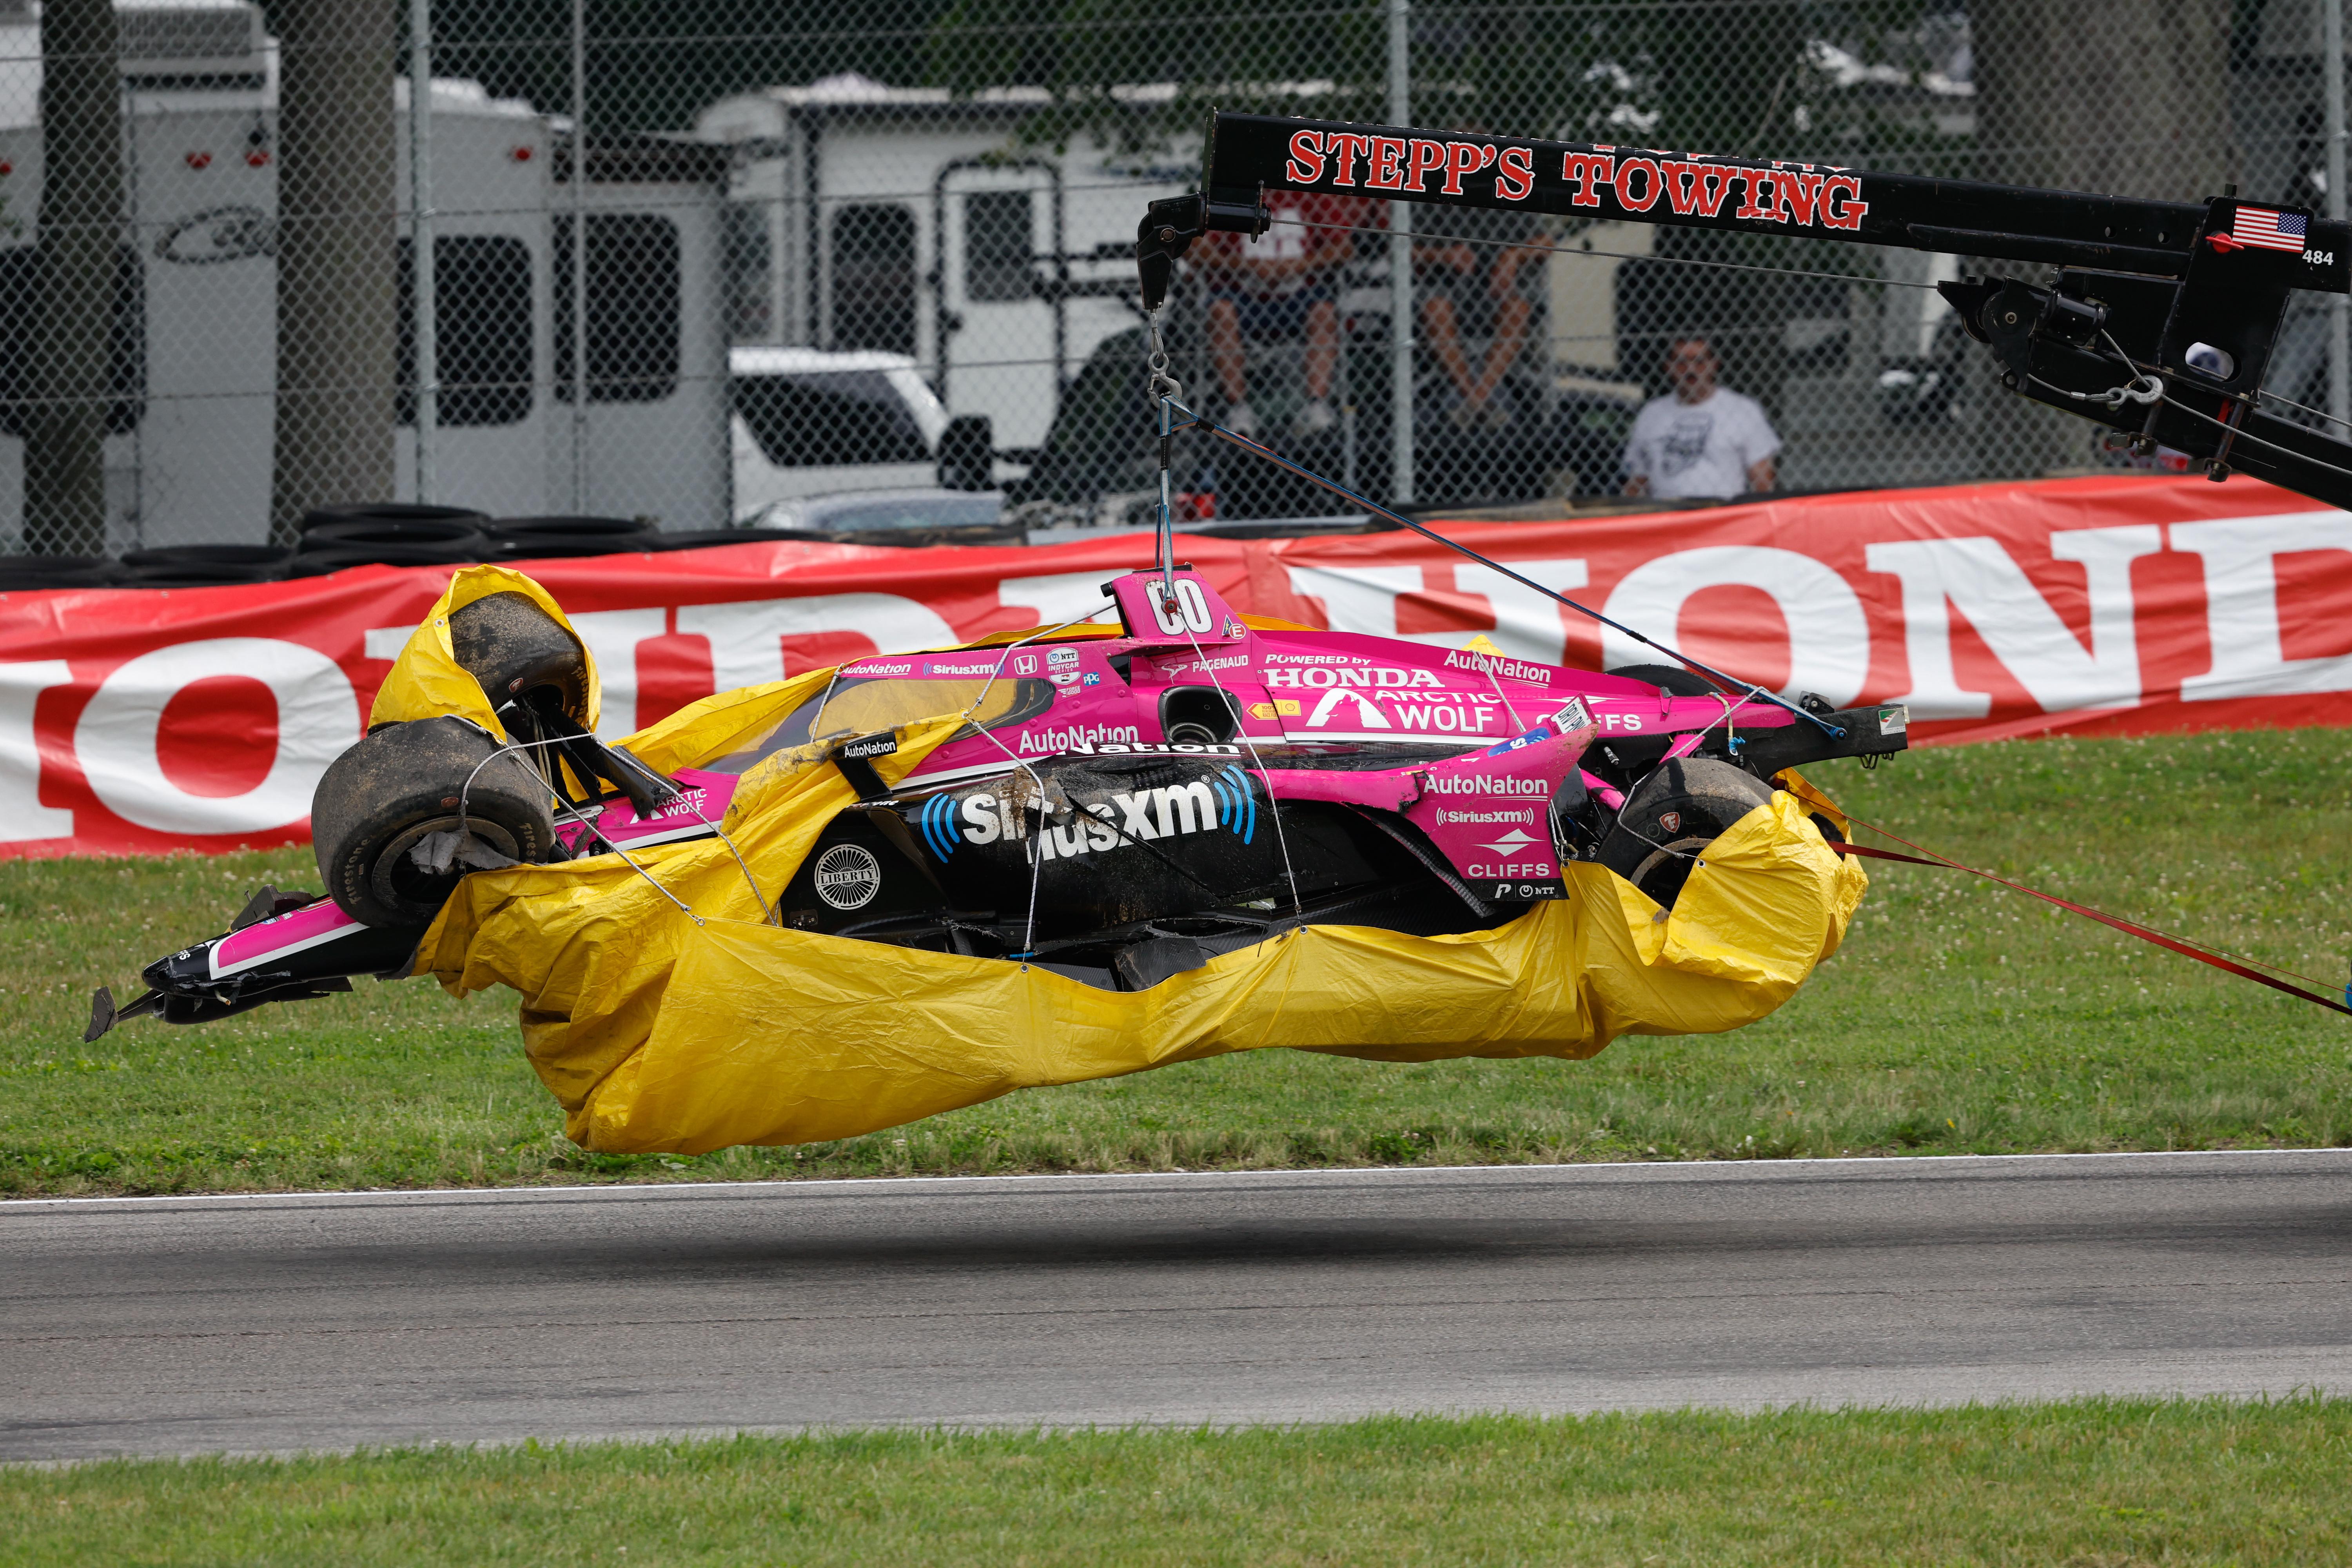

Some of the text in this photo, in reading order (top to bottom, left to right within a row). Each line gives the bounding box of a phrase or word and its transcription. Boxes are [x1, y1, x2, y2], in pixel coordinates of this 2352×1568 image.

[1286, 129, 1869, 231] STEPP'S TOWING
[2302, 249, 2334, 266] 484
[842, 663, 911, 674] AutoNation
[1048, 662, 1079, 671] INDYCAR
[1192, 655, 1249, 673] PAGENAUD
[1265, 653, 1372, 666] POWERED by
[1443, 650, 1551, 683] AutoNation
[1083, 673, 1100, 685] PPG
[1263, 667, 1445, 688] HONDA
[1374, 690, 1502, 704] ARCTIC
[1394, 704, 1494, 733] WOLF
[1019, 724, 1140, 754] AutoNation
[844, 740, 896, 758] AutoNation
[1423, 774, 1548, 794] AutoNation
[656, 788, 708, 808] ARCTIC
[664, 801, 704, 817] WOLF
[344, 839, 370, 905] Firestone
[820, 869, 874, 885] LIBERTY
[1468, 863, 1550, 877] CLIFFS
